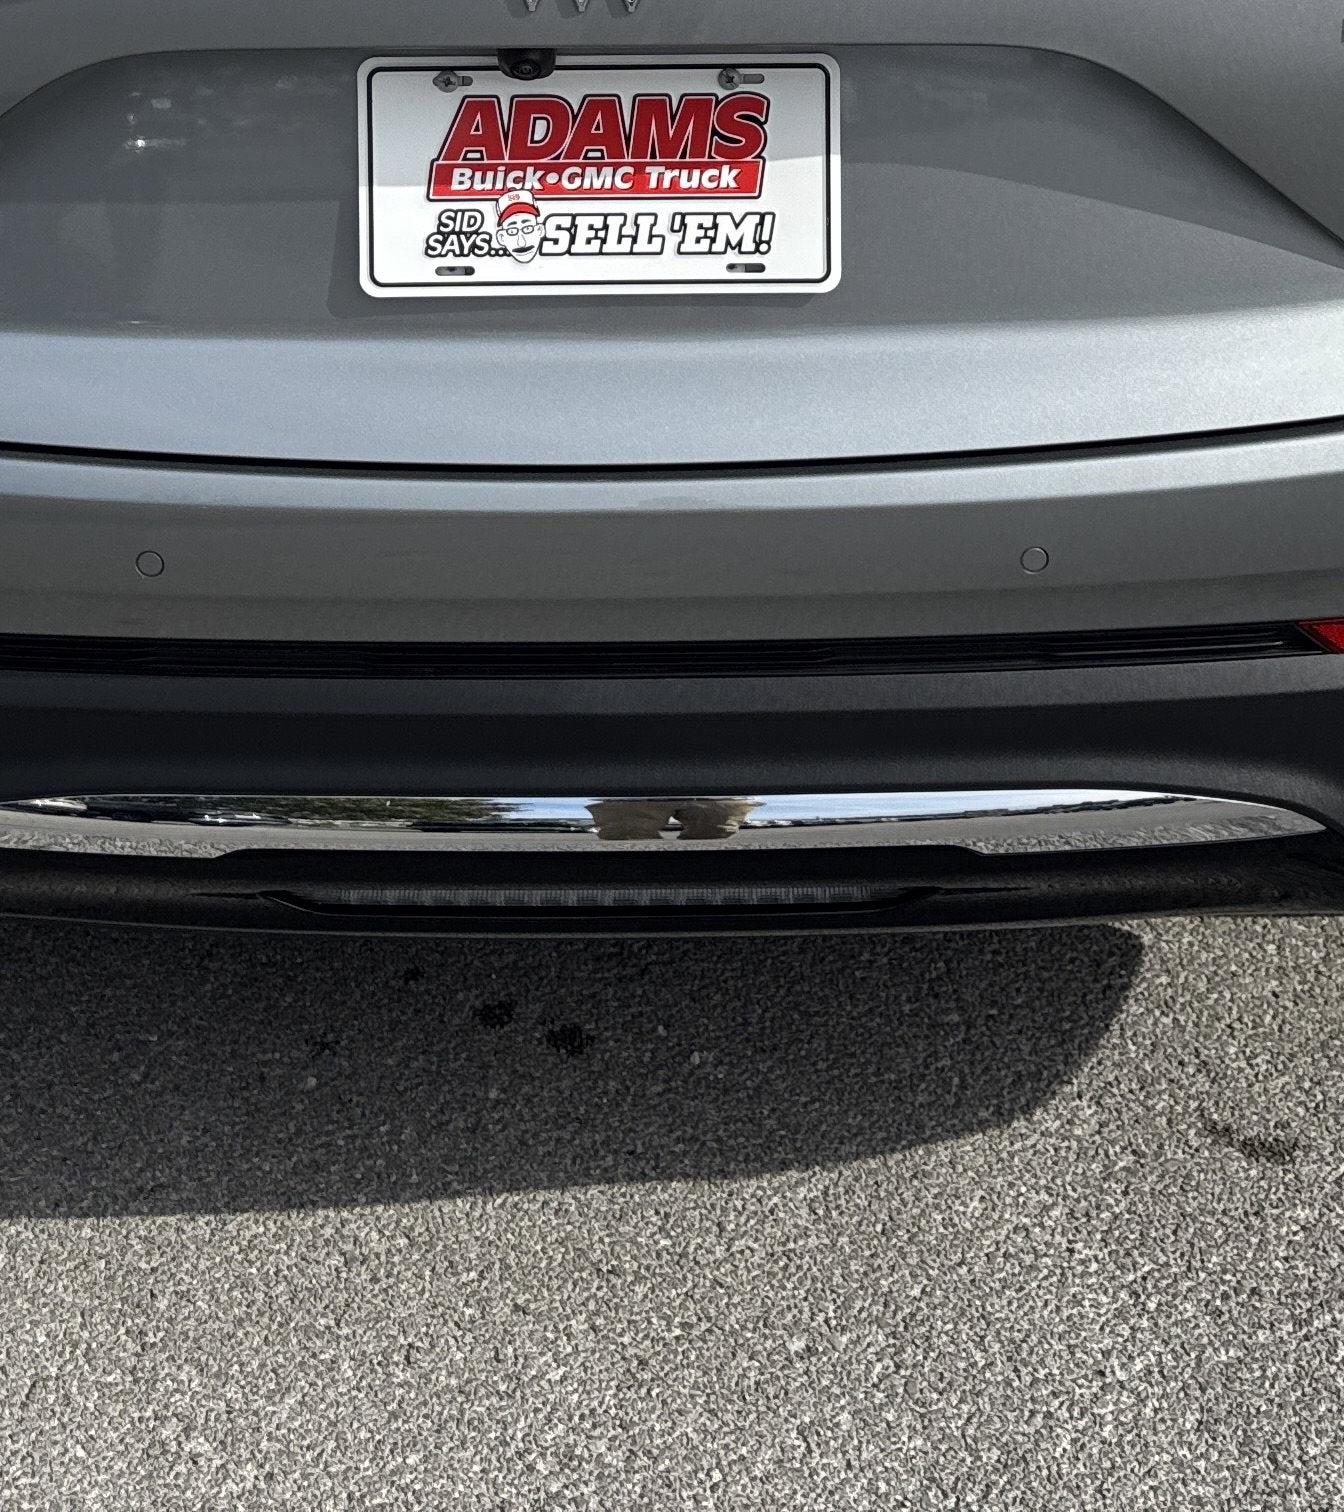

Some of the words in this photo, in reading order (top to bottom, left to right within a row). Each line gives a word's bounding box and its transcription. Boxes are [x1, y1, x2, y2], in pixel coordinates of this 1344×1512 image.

[438, 92, 771, 163] ADAMS
[646, 164, 742, 190] Truck
[437, 209, 484, 234] SID
[540, 214, 666, 256] SELL
[670, 212, 777, 256] 'EM!
